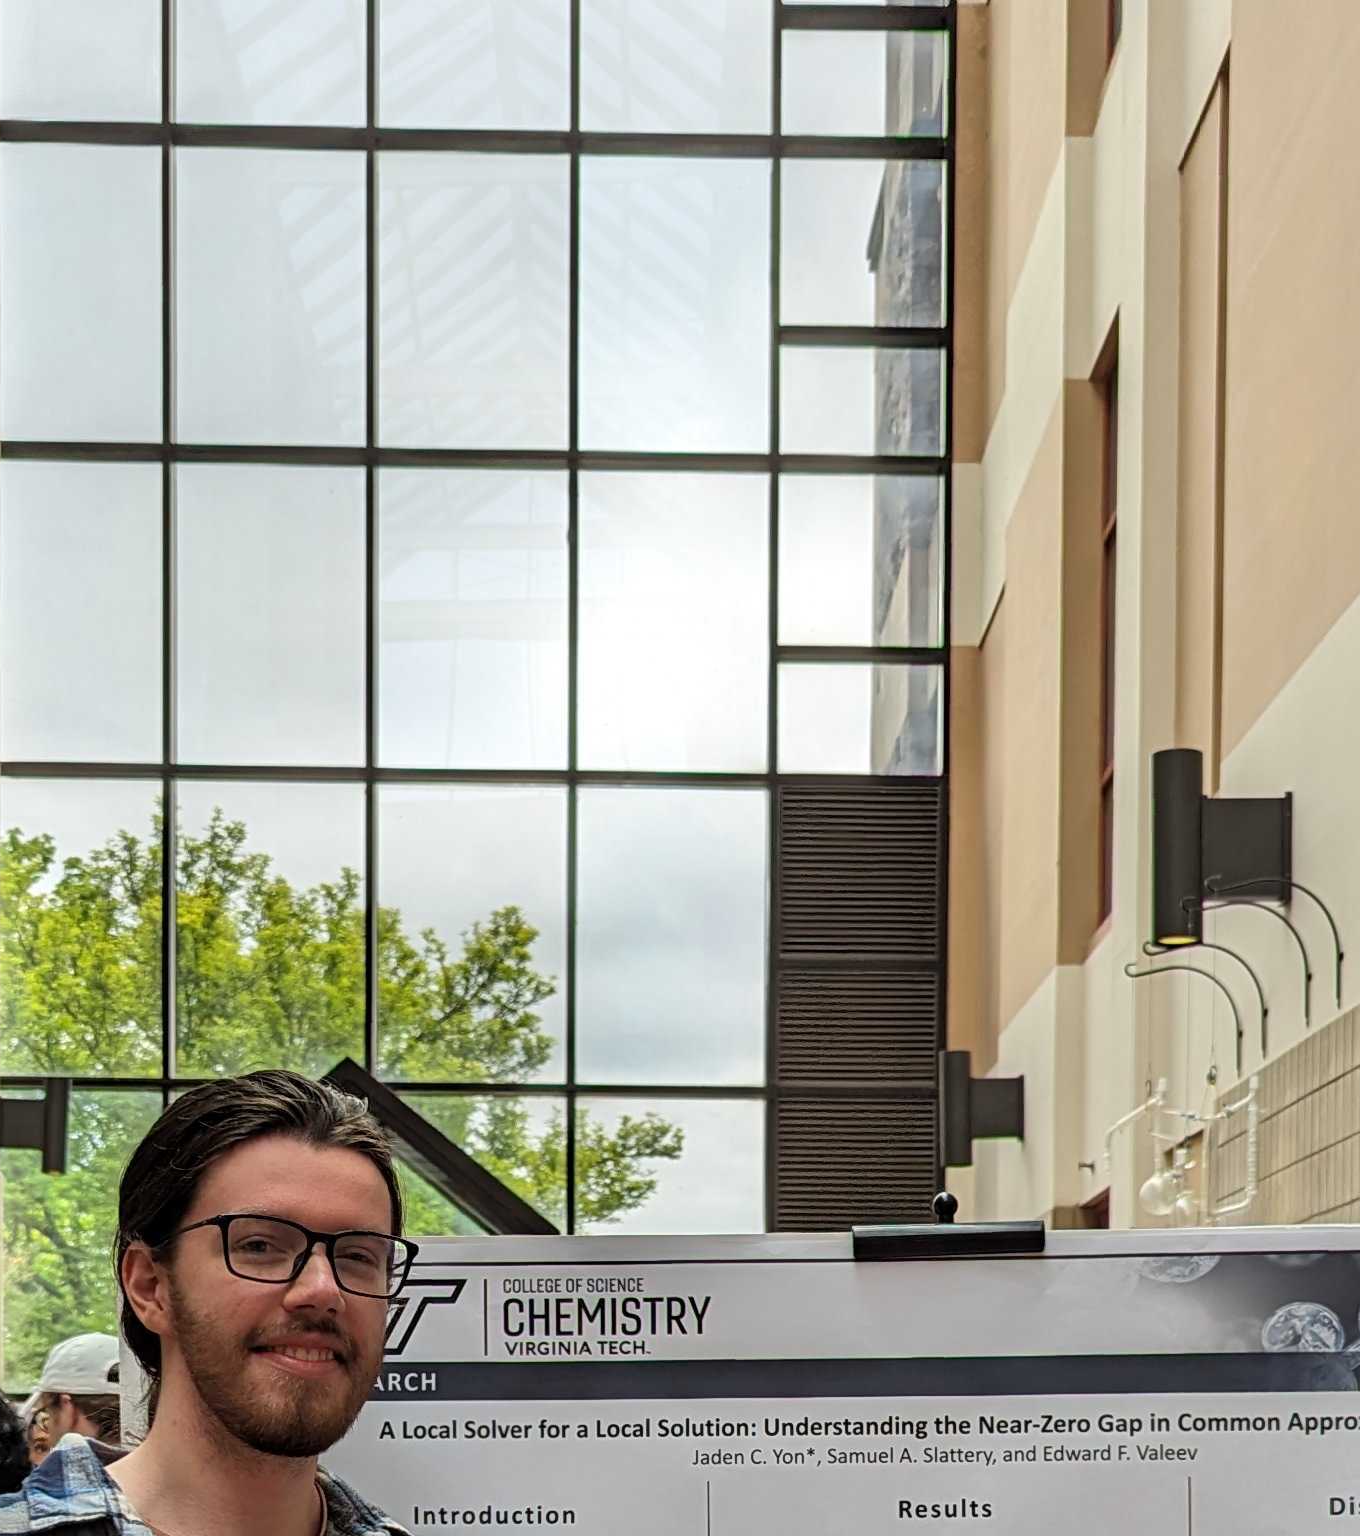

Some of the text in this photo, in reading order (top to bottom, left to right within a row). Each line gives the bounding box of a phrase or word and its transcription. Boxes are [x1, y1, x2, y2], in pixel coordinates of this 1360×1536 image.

[503, 1278, 644, 1293] COLLEGE OF SCIENCE
[504, 1296, 711, 1336] CHEMISTRY
[505, 1341, 592, 1355] VIRGINIA
[380, 1421, 395, 1439] A
[403, 1420, 456, 1439] Local
[464, 1420, 532, 1439] Solver
[539, 1419, 570, 1438] for
[577, 1425, 588, 1438] a
[597, 1419, 650, 1437] Local
[658, 1418, 756, 1437] Solution:
[765, 1416, 927, 1439] Understanding
[934, 1416, 970, 1434] the
[979, 1415, 1090, 1434] Near-Zero
[1098, 1414, 1142, 1436] Gap
[1150, 1413, 1169, 1432] in
[1178, 1414, 1280, 1431] Common
[692, 1449, 744, 1465] Jaden
[751, 1449, 766, 1464] C.
[828, 1447, 893, 1463] Samuel
[900, 1448, 917, 1463] A.
[924, 1447, 996, 1466] Slattery,
[1003, 1445, 1036, 1462] and
[1044, 1444, 1111, 1461] Edward
[1118, 1445, 1130, 1460] F.
[1136, 1444, 1197, 1460] Valeev
[414, 1505, 574, 1524] Introduction
[899, 1499, 991, 1518] Results
